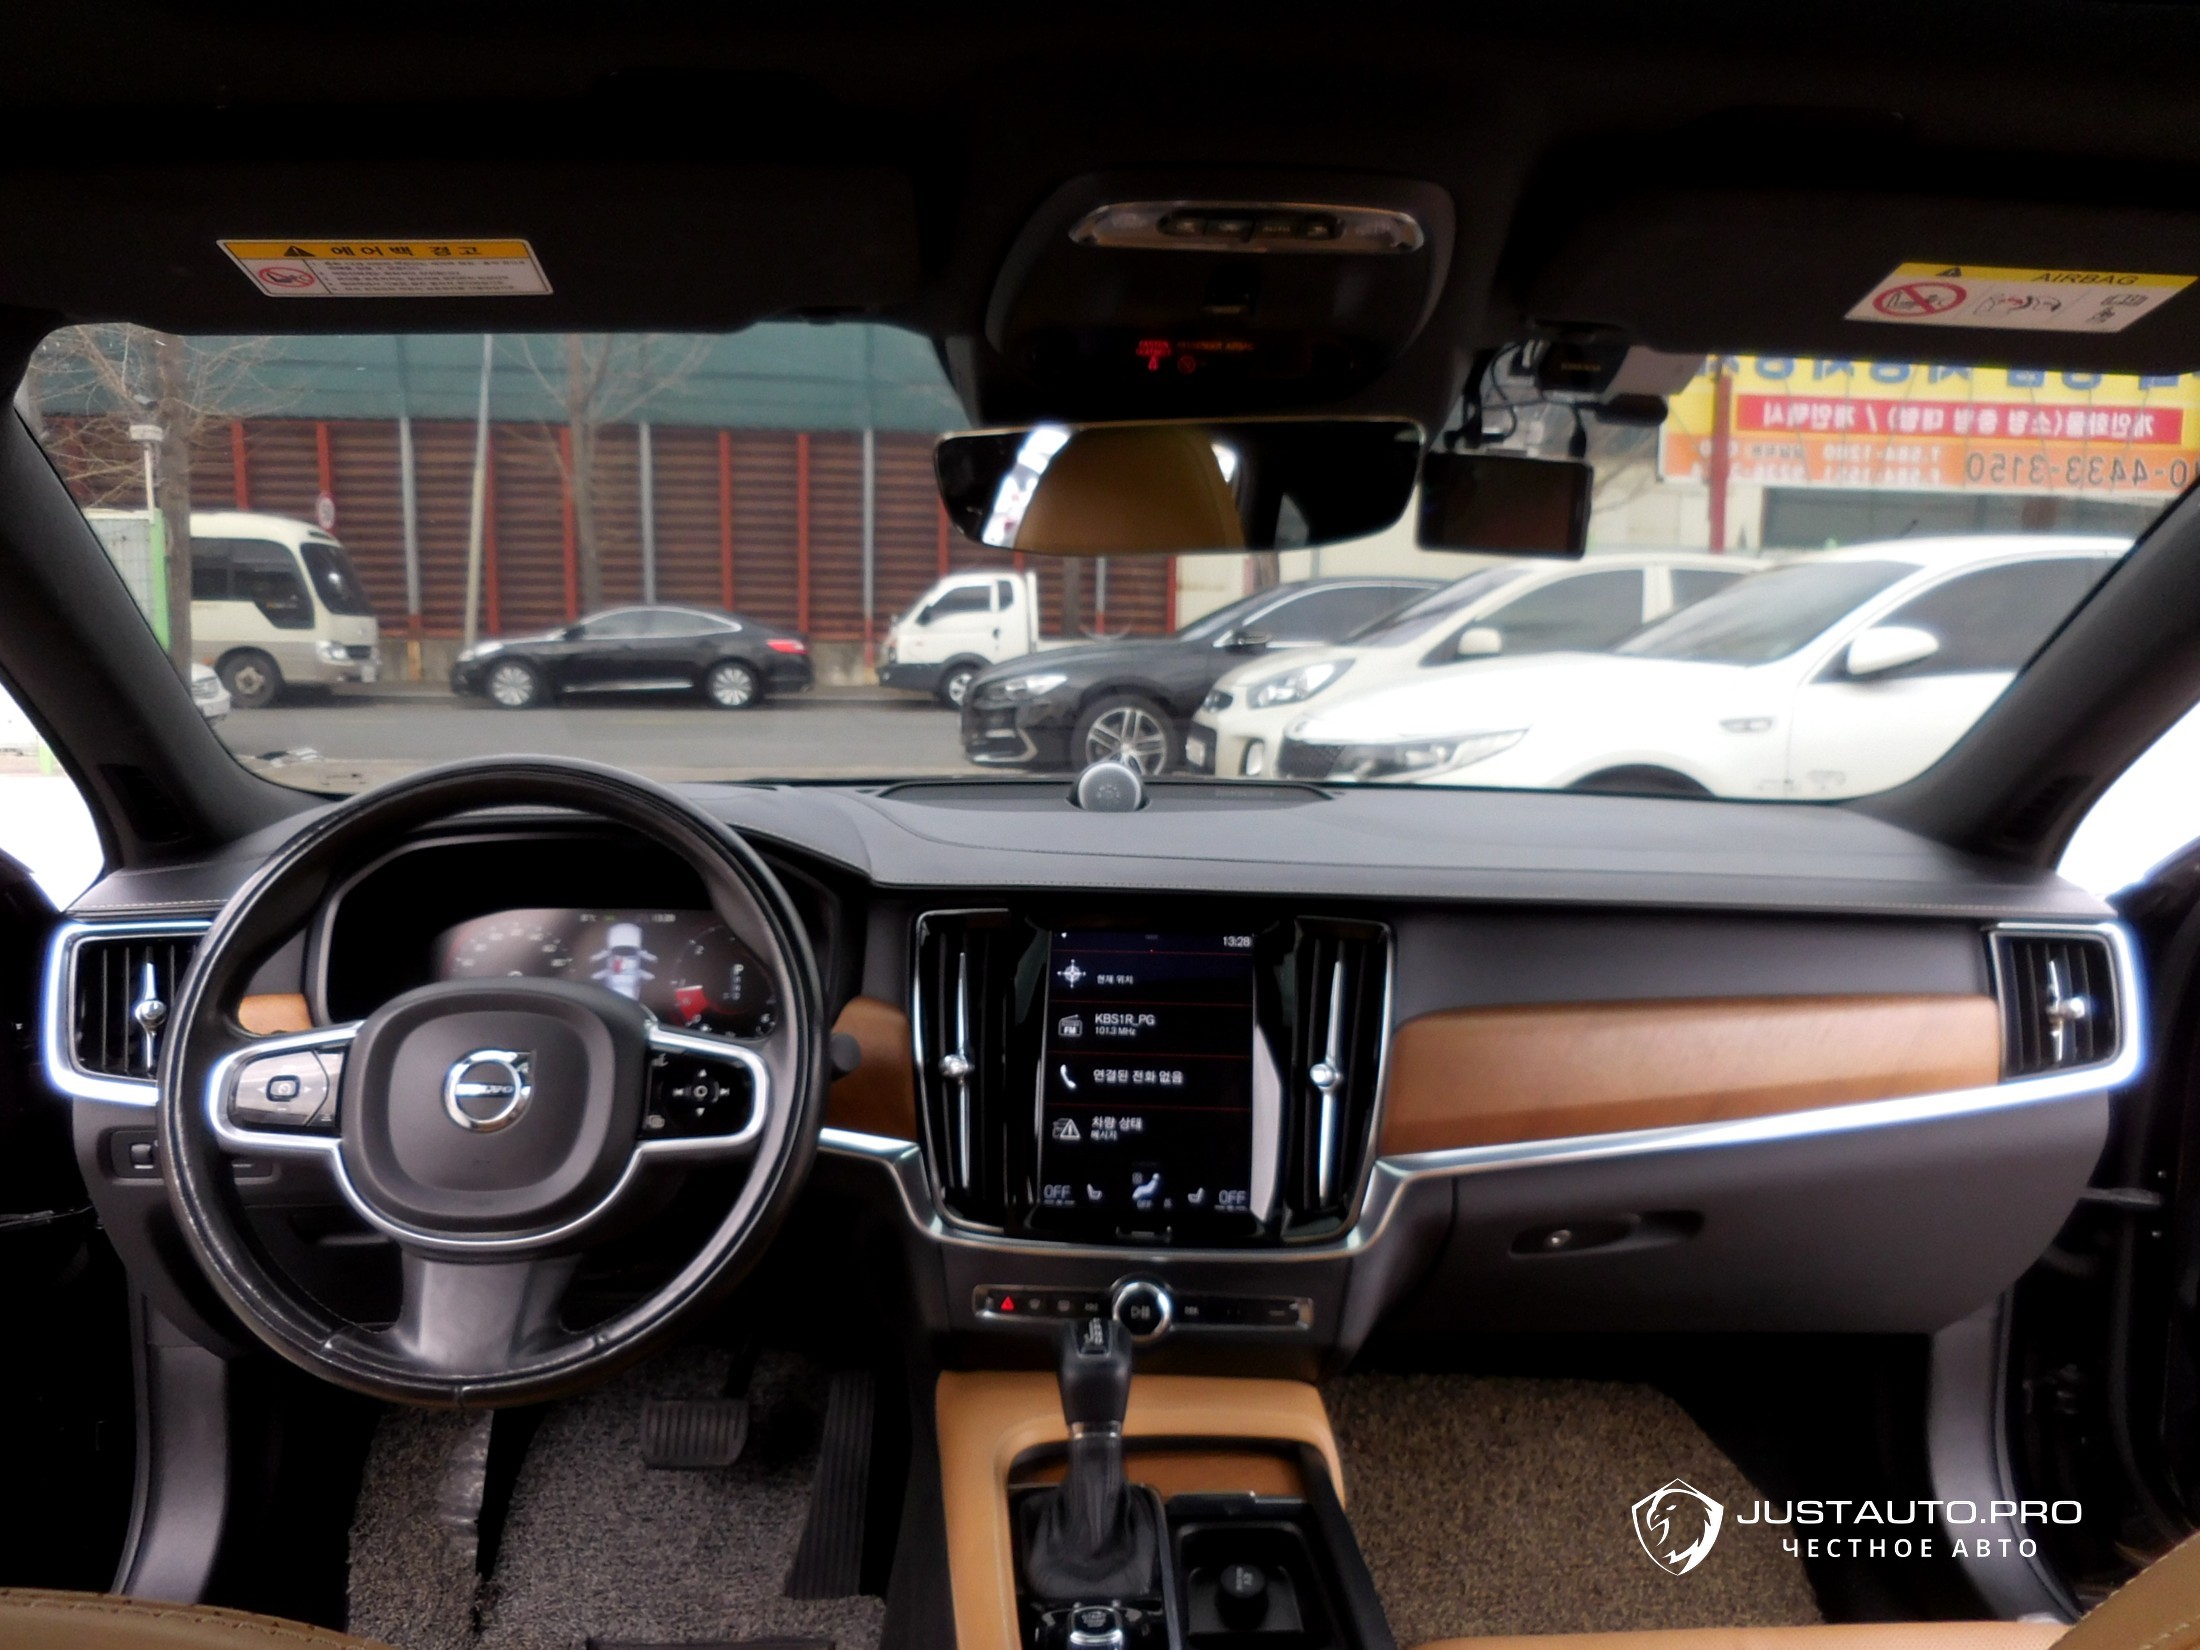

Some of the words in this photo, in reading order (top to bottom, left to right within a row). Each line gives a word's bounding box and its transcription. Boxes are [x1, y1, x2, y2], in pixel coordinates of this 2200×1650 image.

[2033, 271, 2140, 286] AIRBAG
[1222, 936, 1251, 948] 13:28
[1095, 1013, 1156, 1027] KBS1R_PG
[1063, 1025, 1077, 1035] FM
[1093, 1069, 1129, 1083] 연결된
[1132, 1069, 1156, 1084] 전화
[1158, 1070, 1184, 1085] 없음
[1091, 1115, 1116, 1130] 차량
[1118, 1116, 1143, 1132] 상태
[1043, 1184, 1072, 1199] OFF
[1218, 1189, 1247, 1205] OFF
